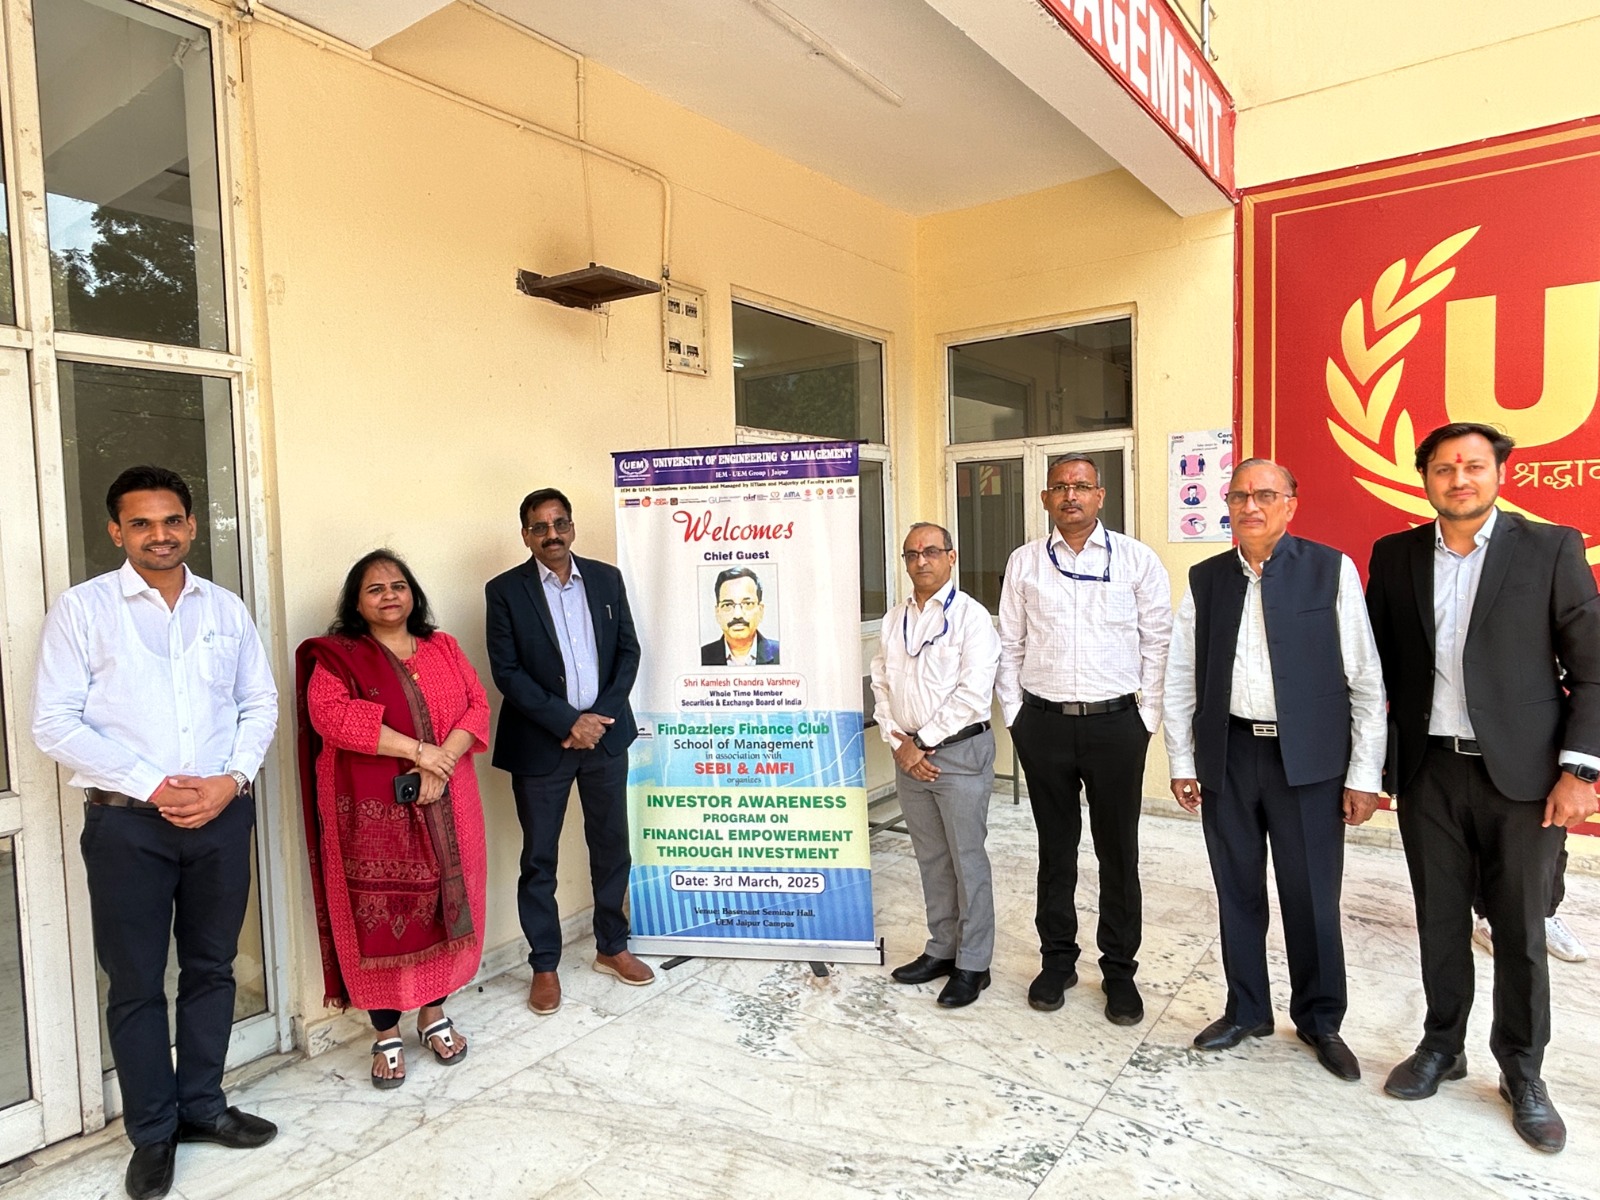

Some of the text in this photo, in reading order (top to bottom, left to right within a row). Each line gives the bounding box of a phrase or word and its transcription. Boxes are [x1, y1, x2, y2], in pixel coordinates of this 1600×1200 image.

[1060, 0, 1222, 178] GEMENT
[652, 448, 853, 468] UNIVERSITY OF ENGINEERING & MANAGEMENT
[623, 460, 644, 470] UEM
[732, 470, 748, 478] UEM
[748, 470, 766, 478] Group
[771, 468, 789, 478] Jaipur
[672, 510, 794, 542] Welcomes
[704, 550, 770, 561] Chief Guest
[684, 678, 800, 688] Shri Kamlesh Chandra Varshney
[682, 698, 714, 706] Securities
[722, 699, 754, 708] Exchange
[658, 722, 830, 736] FinDazzlers Finance Club
[674, 738, 814, 752] School of Management
[705, 750, 782, 760] in association with
[694, 762, 794, 774] SEBI & AMFI
[726, 776, 762, 786] organizes
[647, 795, 847, 809] INVESTOR AWARENESS
[703, 814, 788, 824] PROGRAM ON
[642, 828, 854, 842] FINANCIAL EMPOWERMENT
[656, 846, 840, 860] THROUGH INVESTMENT
[675, 874, 820, 890] Date: 3rd March, 2025
[694, 907, 720, 915] Venue:
[762, 908, 794, 916] Seminar
[736, 919, 760, 928] Jaipur
[762, 920, 794, 928] Campus
